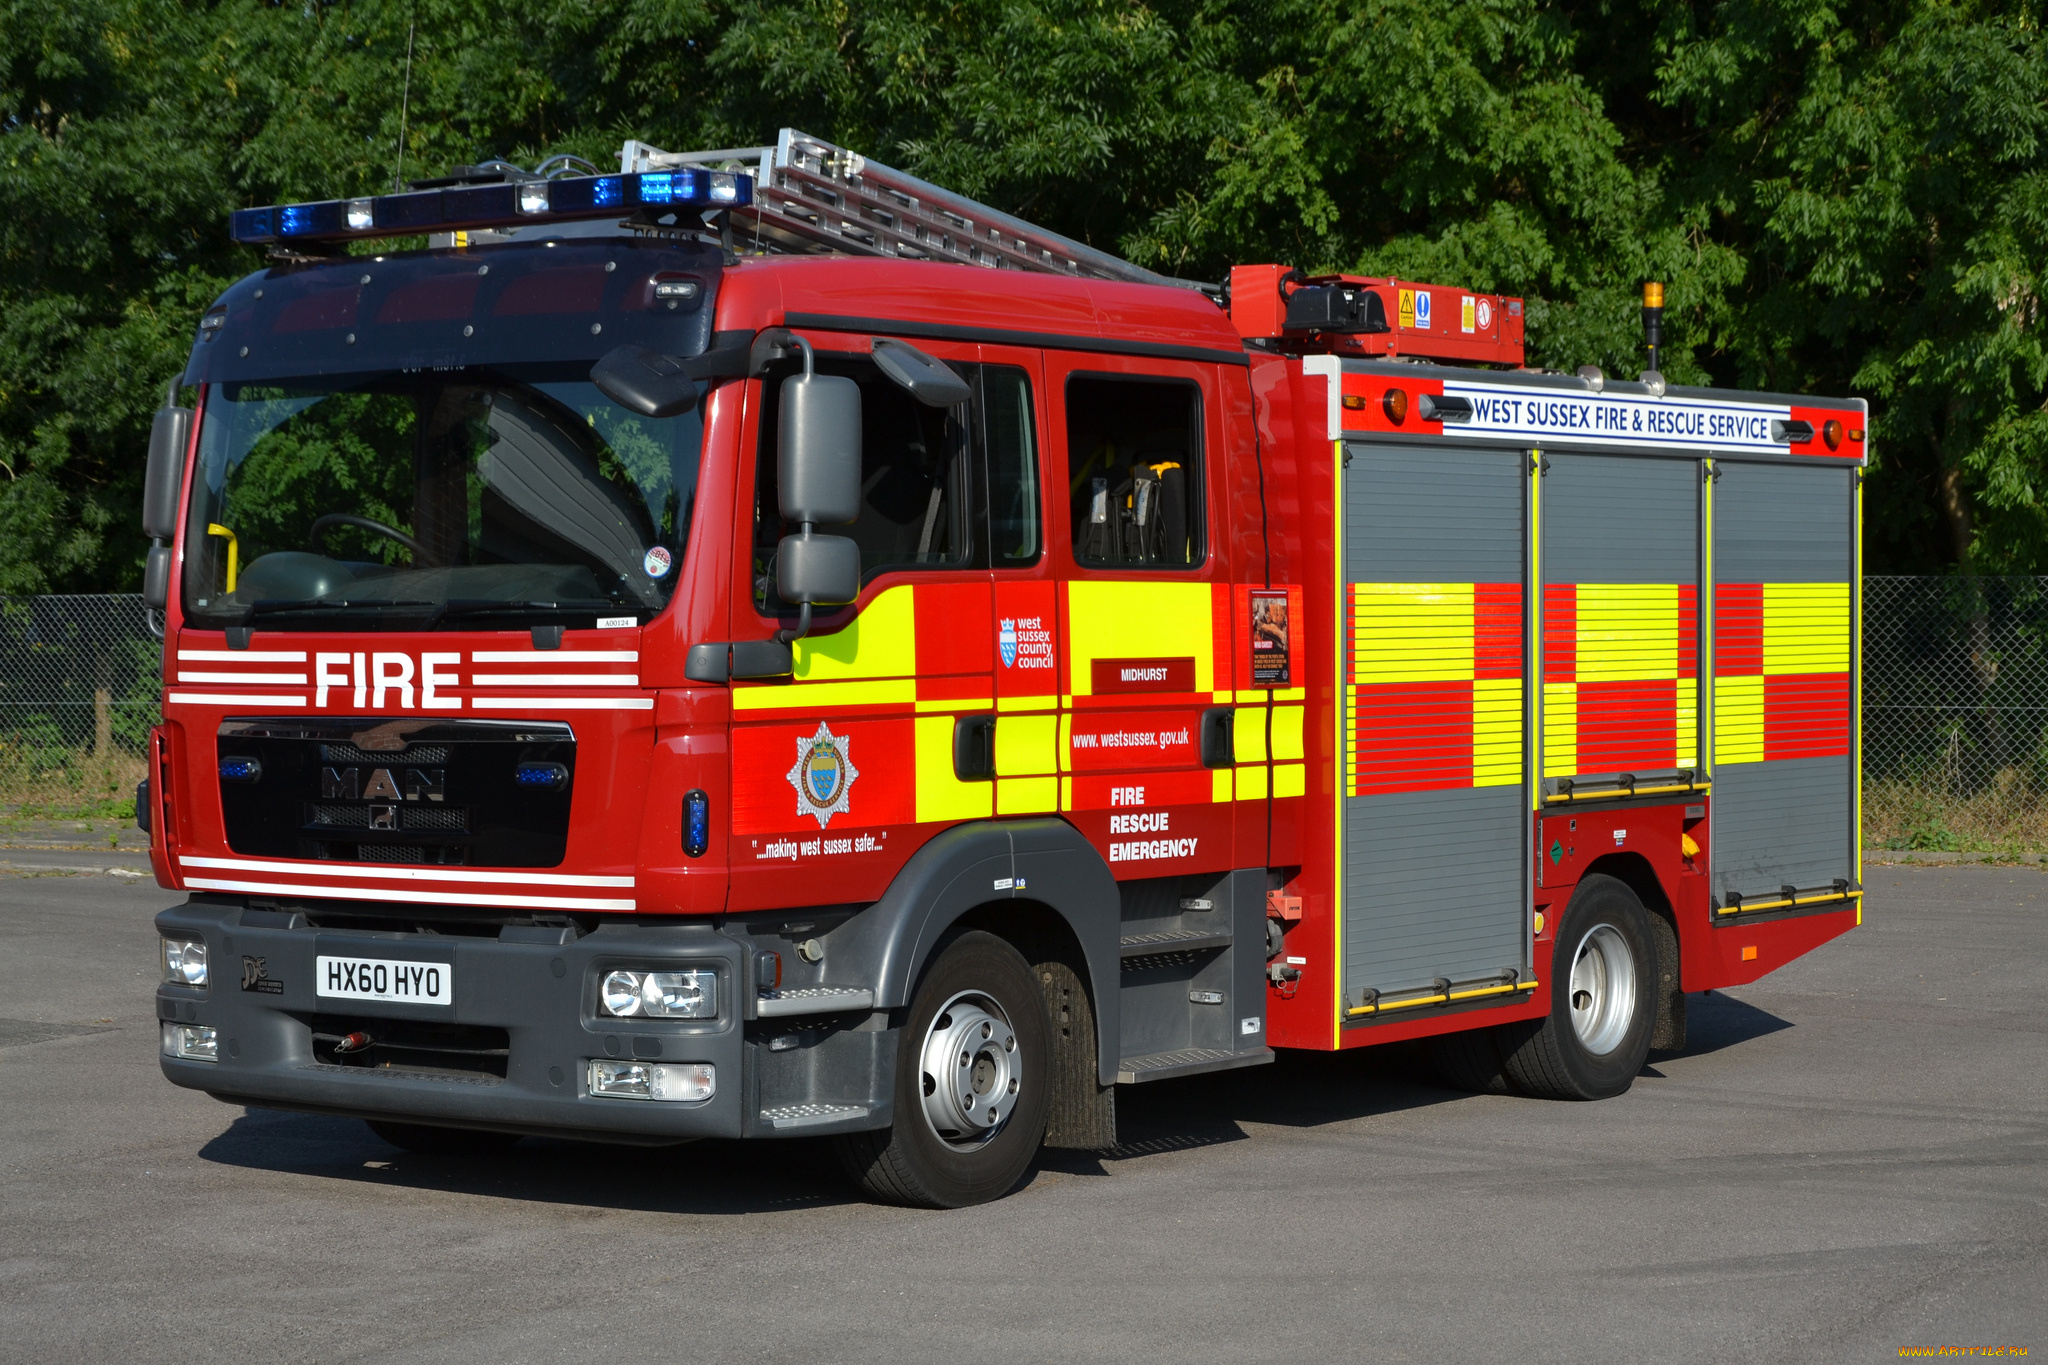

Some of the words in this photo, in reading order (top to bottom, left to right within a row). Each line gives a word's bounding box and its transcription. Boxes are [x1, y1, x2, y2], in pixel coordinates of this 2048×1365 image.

[1473, 398, 1521, 424] WEST
[1527, 401, 1590, 428] SUSSEX
[1596, 406, 1627, 431] FIRE
[1632, 409, 1643, 431] &
[1648, 411, 1704, 435] RESCUE
[1709, 415, 1767, 439] SERVICE
[1017, 616, 1041, 629] west
[1017, 630, 1050, 642] sussex
[1018, 642, 1052, 658] county
[1018, 653, 1053, 668] council
[315, 652, 463, 709] FIRE
[1121, 668, 1168, 681] MIDHURST
[1160, 727, 1189, 750] gov.uk
[322, 767, 444, 801] MAN
[1111, 786, 1145, 806] FIRE
[1110, 812, 1169, 834] RESCUE
[800, 837, 821, 856] west
[823, 838, 852, 854] sussex
[1109, 838, 1198, 862] EMERGENCY
[328, 961, 387, 993] HX60
[395, 966, 439, 997] HYO
